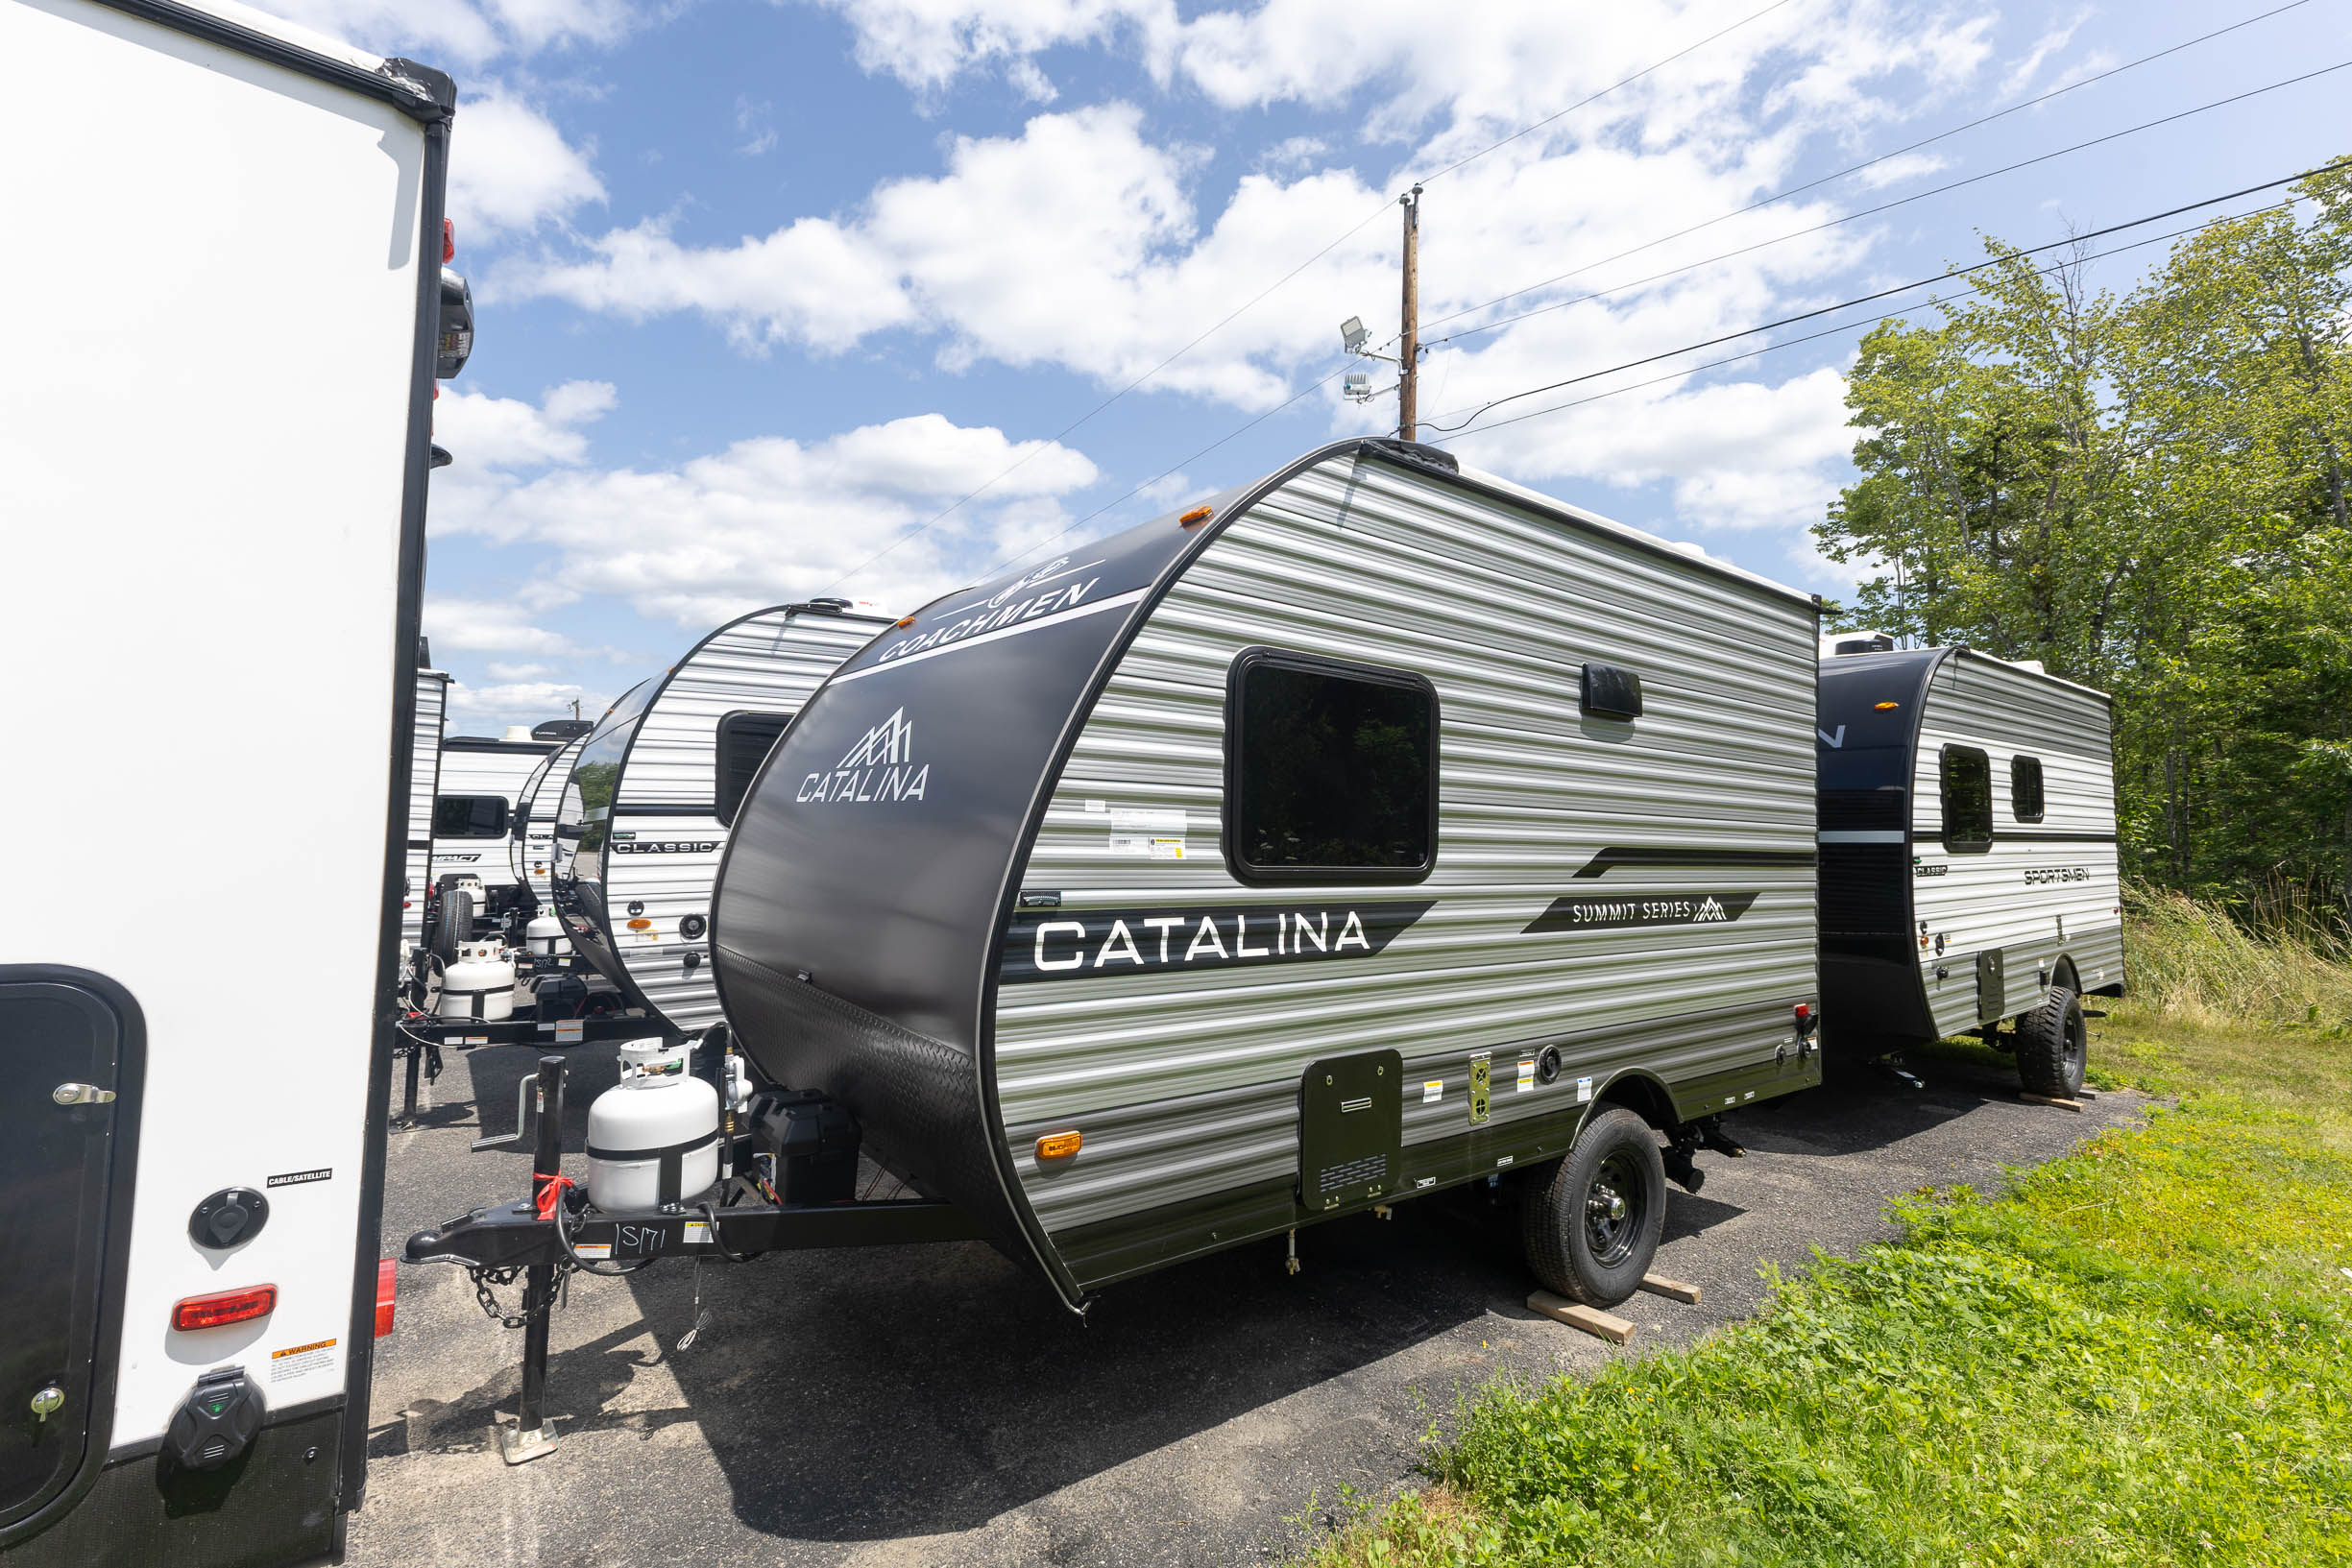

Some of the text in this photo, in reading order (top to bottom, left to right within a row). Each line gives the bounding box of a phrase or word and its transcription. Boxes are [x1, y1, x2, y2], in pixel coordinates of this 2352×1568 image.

[879, 577, 1101, 663] COACHMEN
[796, 764, 930, 803] CATALINA
[617, 842, 713, 854] CLASSIC
[1917, 866, 1947, 876] CLASSIC
[2025, 867, 2091, 885] SPORTSMEN
[1573, 901, 1690, 923] SUMMIT SERIES
[1033, 910, 1370, 972] CATALINA
[268, 1170, 331, 1185] CABLE/SATELLITE
[289, 1341, 327, 1355] WARNING
